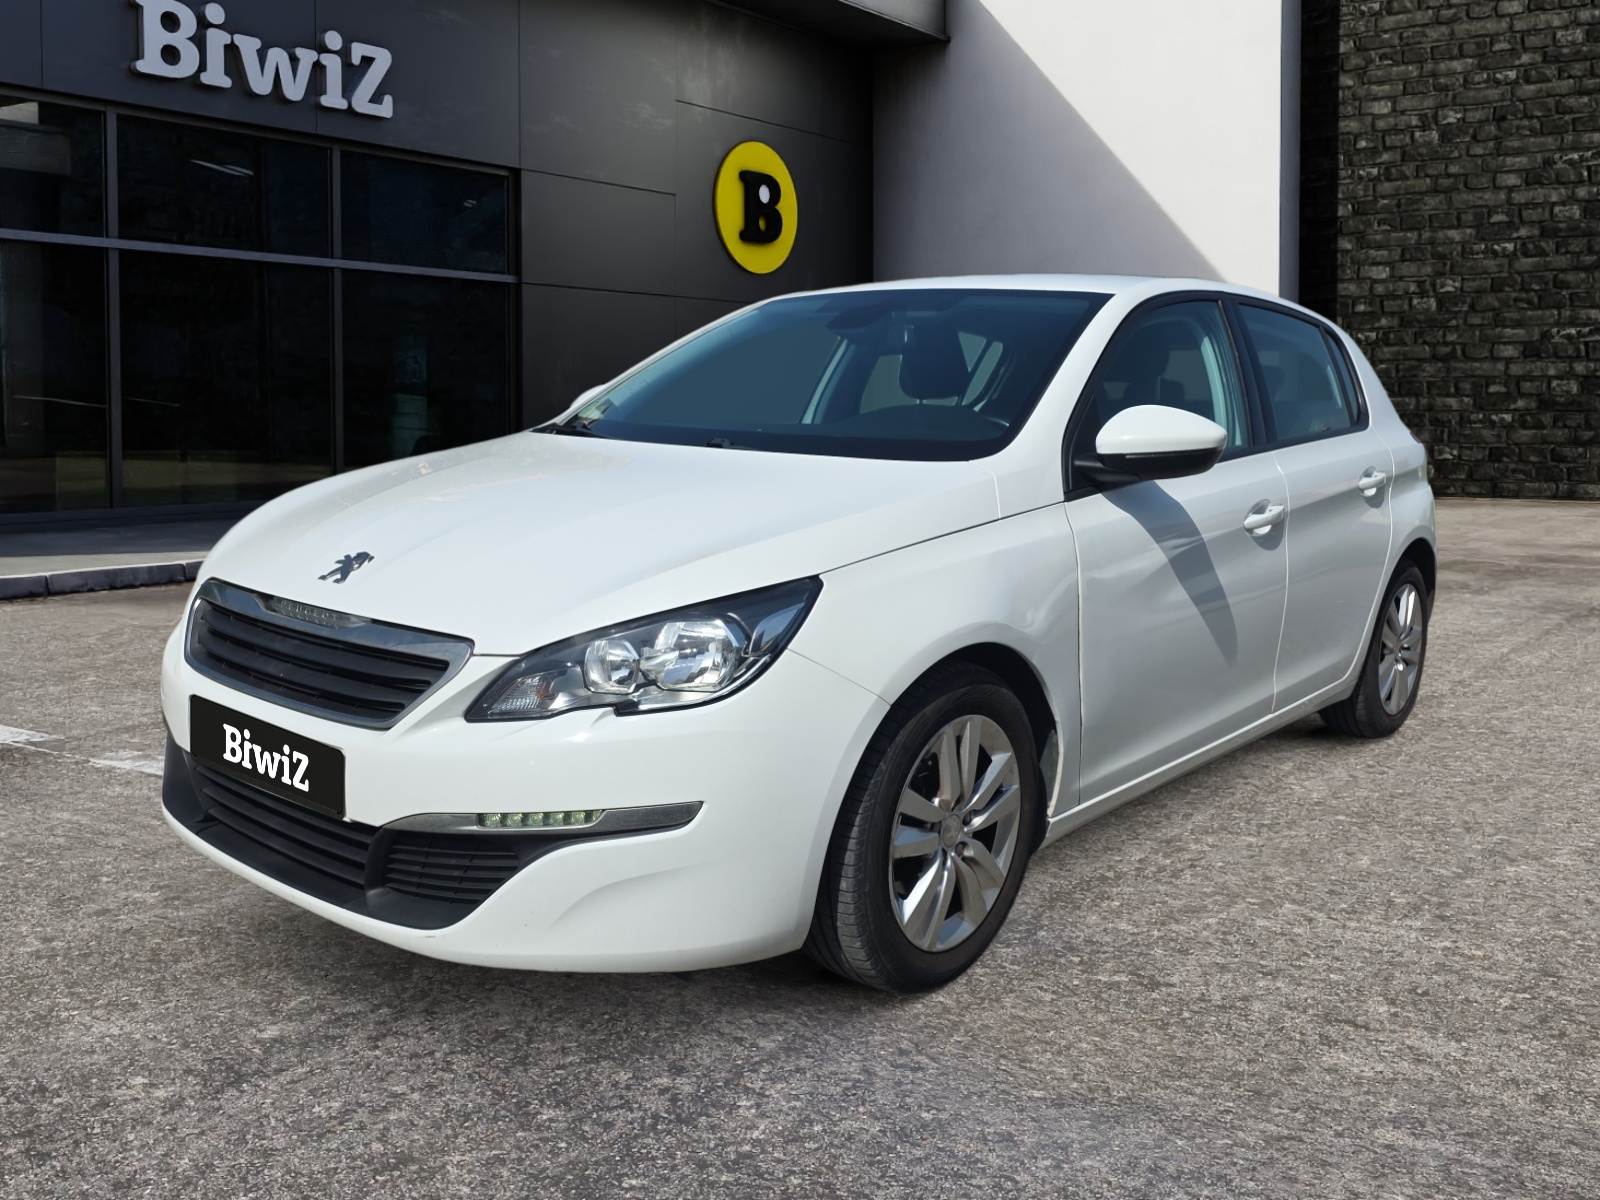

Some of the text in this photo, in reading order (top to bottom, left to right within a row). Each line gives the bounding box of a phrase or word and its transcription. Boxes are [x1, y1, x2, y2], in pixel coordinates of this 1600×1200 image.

[134, 0, 393, 118] BiwiZ
[739, 169, 783, 245] B
[280, 600, 339, 622] PEUGEOT
[222, 723, 310, 792] BiwiZ
